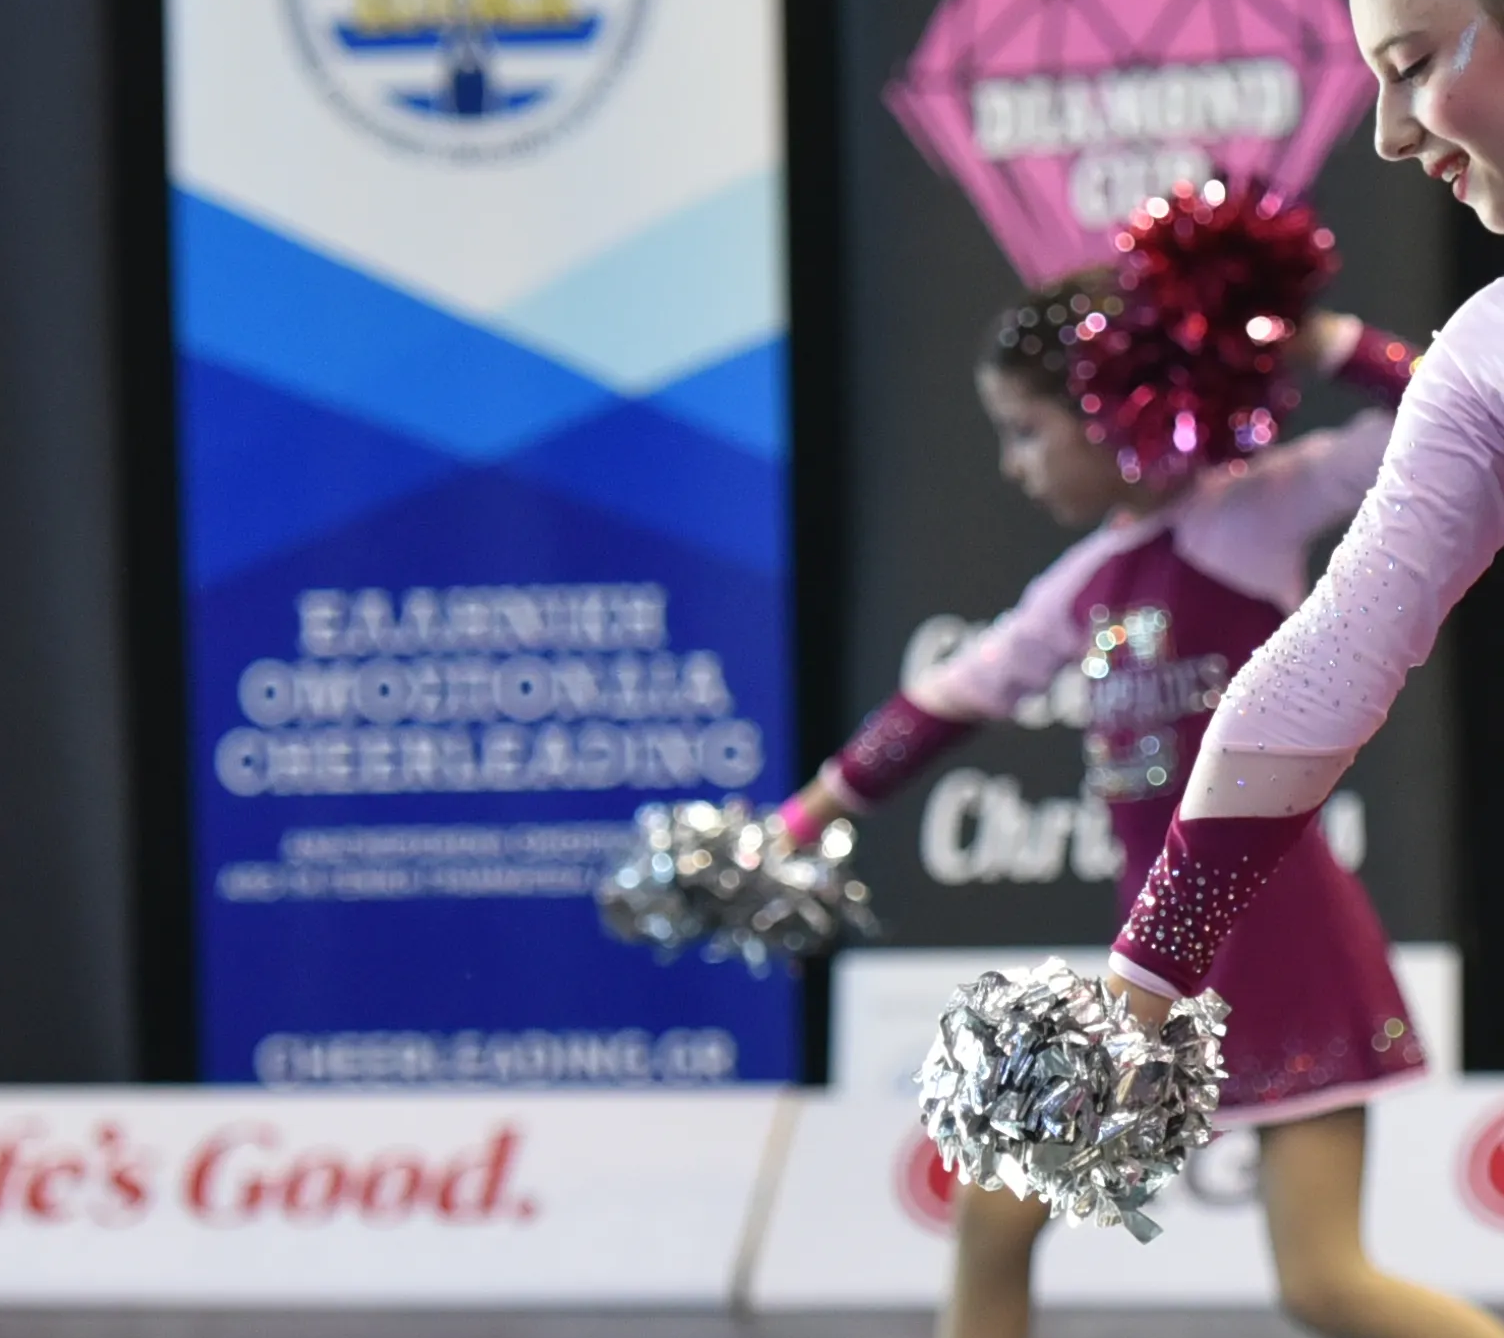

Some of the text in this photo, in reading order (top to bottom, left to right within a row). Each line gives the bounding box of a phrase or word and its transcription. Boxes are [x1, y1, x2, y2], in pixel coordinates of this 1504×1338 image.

[976, 61, 1300, 157] DIAMOND
[220, 723, 759, 791] CHEERLEADING
[180, 1114, 543, 1229] Good.
